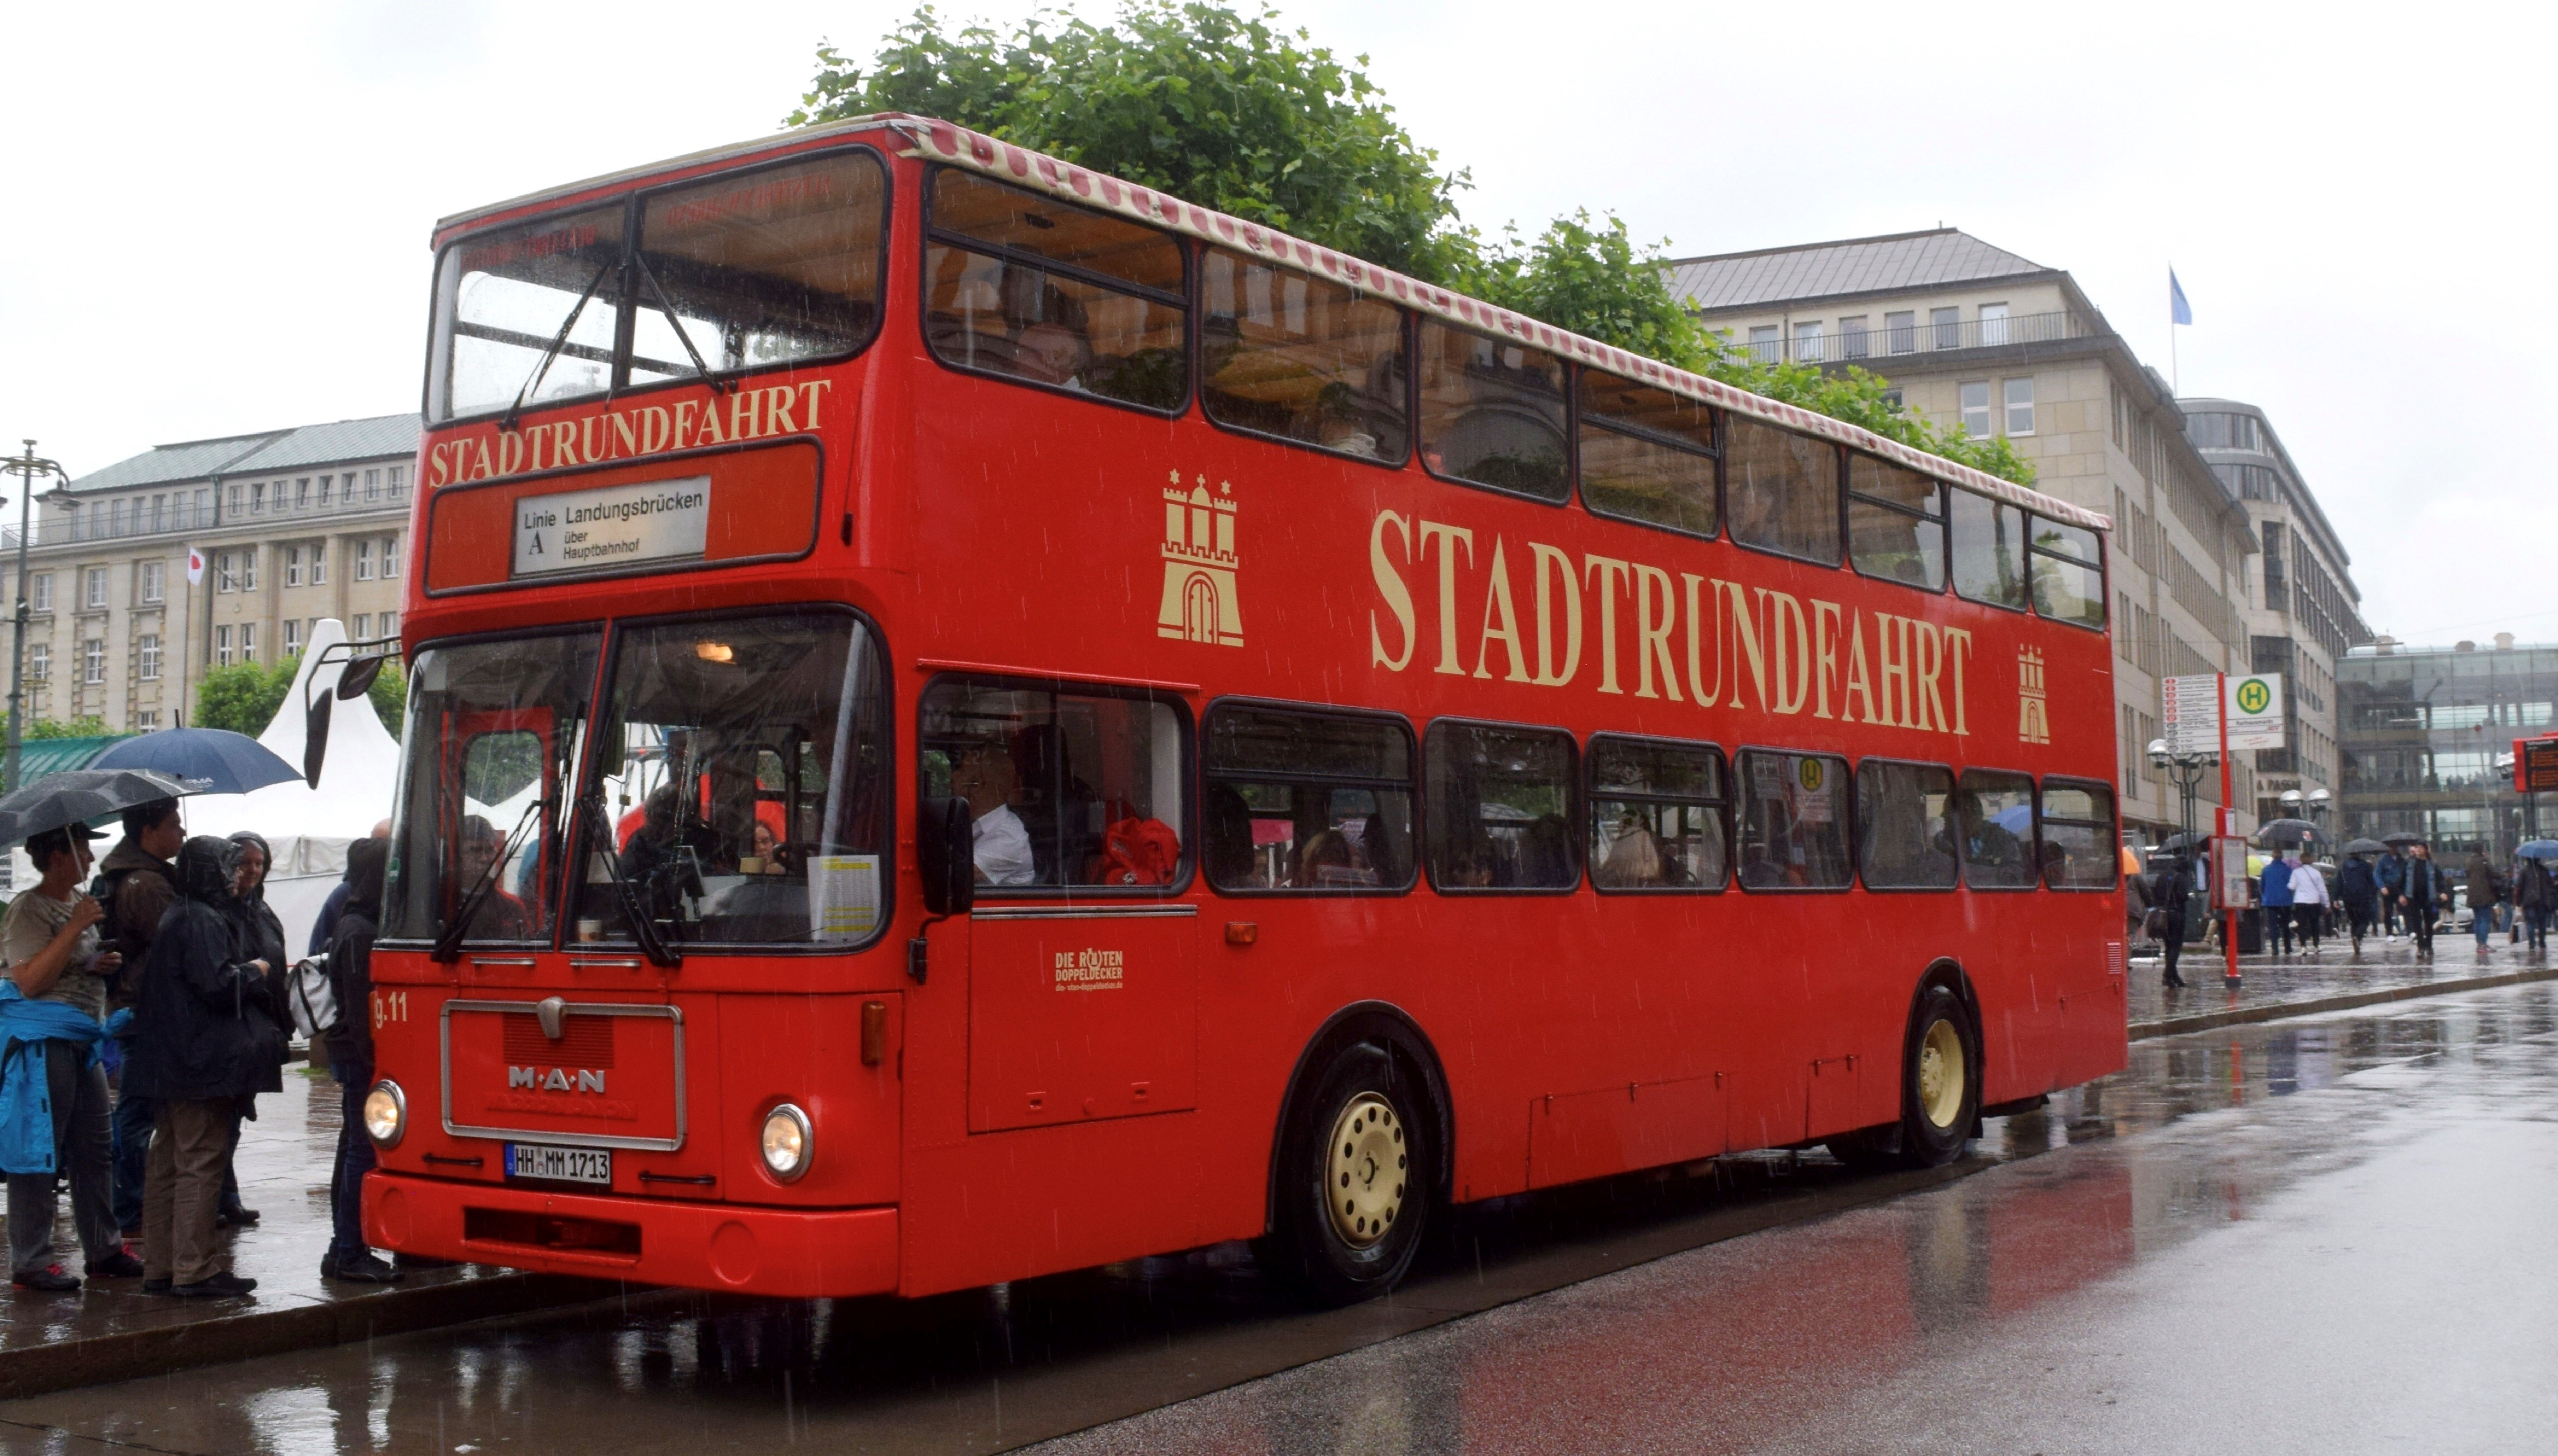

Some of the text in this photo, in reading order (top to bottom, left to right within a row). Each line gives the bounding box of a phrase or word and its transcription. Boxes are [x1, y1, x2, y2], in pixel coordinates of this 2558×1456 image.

[429, 380, 831, 488] STADTRUNDFAHRT
[524, 491, 703, 529] Linie Landungsbrücken
[529, 531, 544, 555] A
[563, 538, 640, 561] Hauptbahnhof
[564, 532, 588, 544] über
[1370, 509, 1972, 736] STADTRUNDFAHRT
[1055, 952, 1074, 968] DIE
[1055, 967, 1123, 981] DOPPELDECKER
[515, 1148, 608, 1179] HH MM 1713
